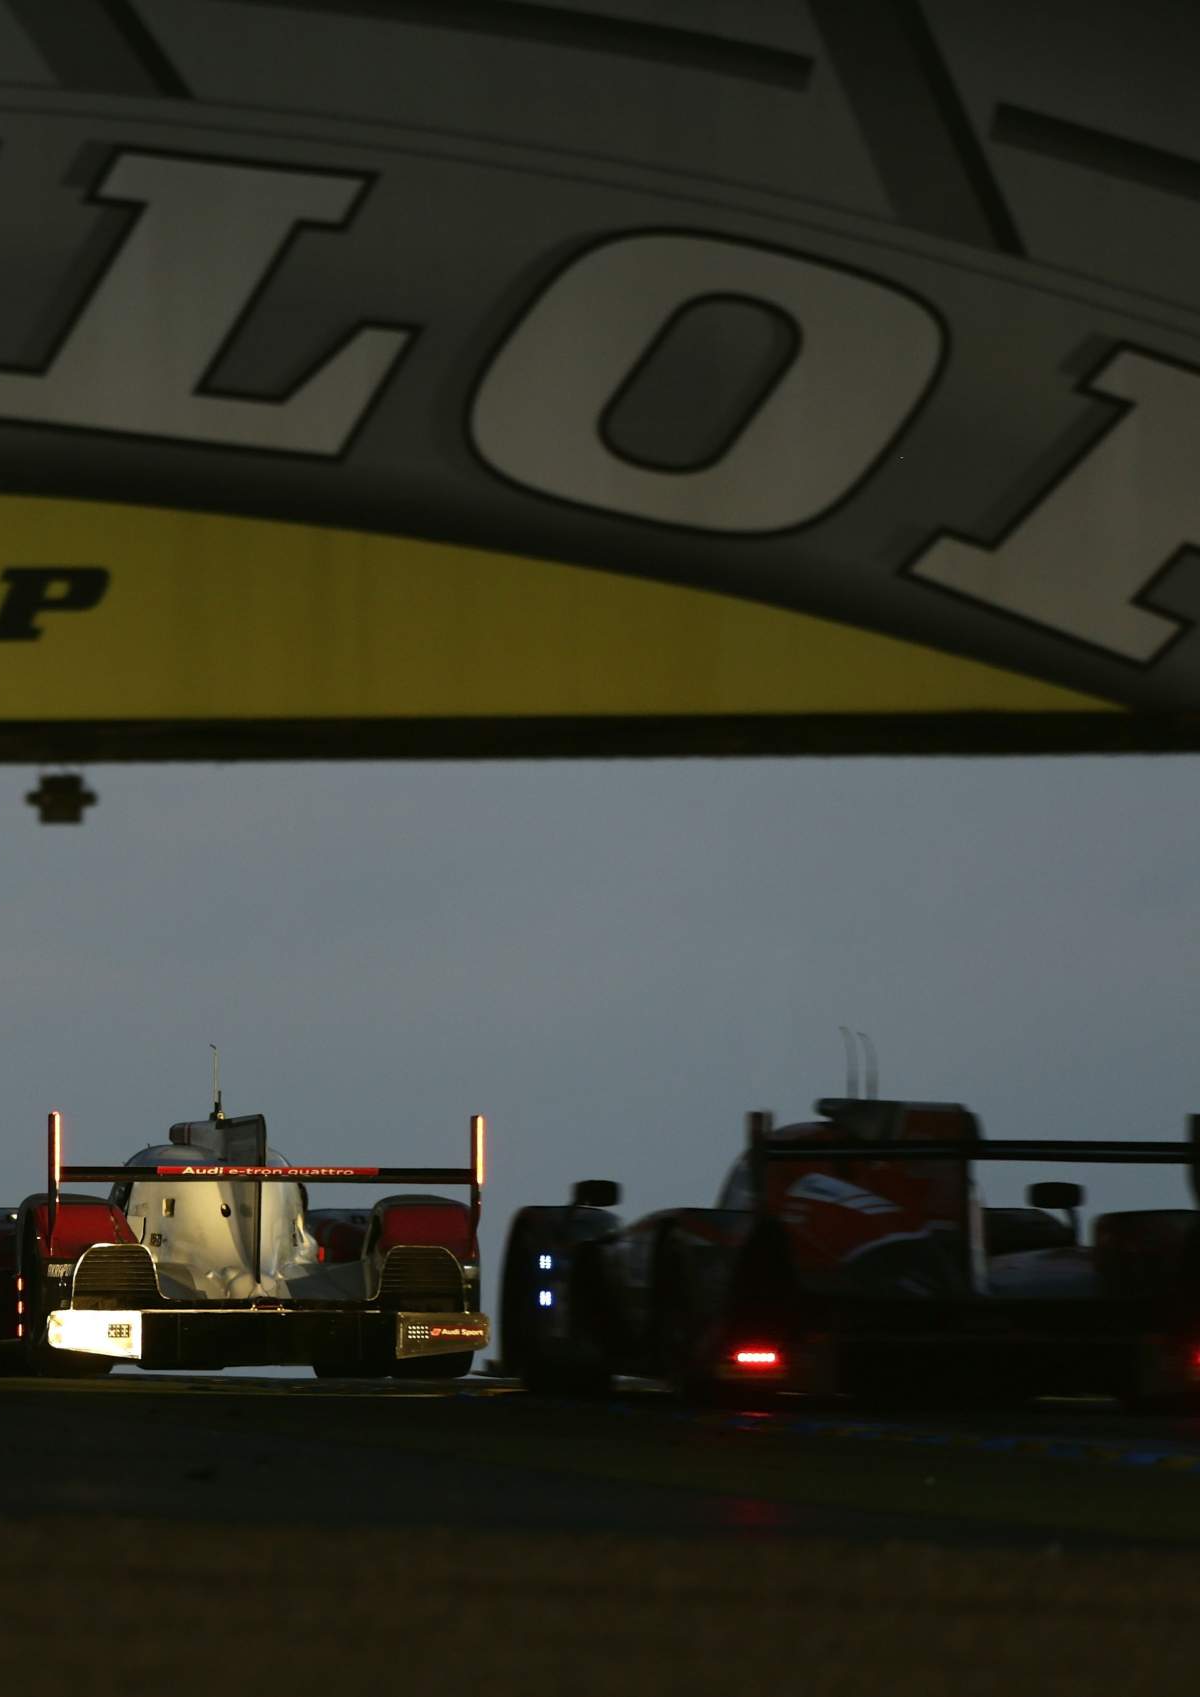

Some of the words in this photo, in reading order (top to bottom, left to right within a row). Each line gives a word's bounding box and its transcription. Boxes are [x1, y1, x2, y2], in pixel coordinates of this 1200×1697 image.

[181, 1166, 224, 1175] Audi
[228, 1167, 282, 1176] e-tron
[287, 1168, 355, 1177] quattro
[441, 1328, 460, 1336] Audi
[462, 1328, 484, 1337] Sport
